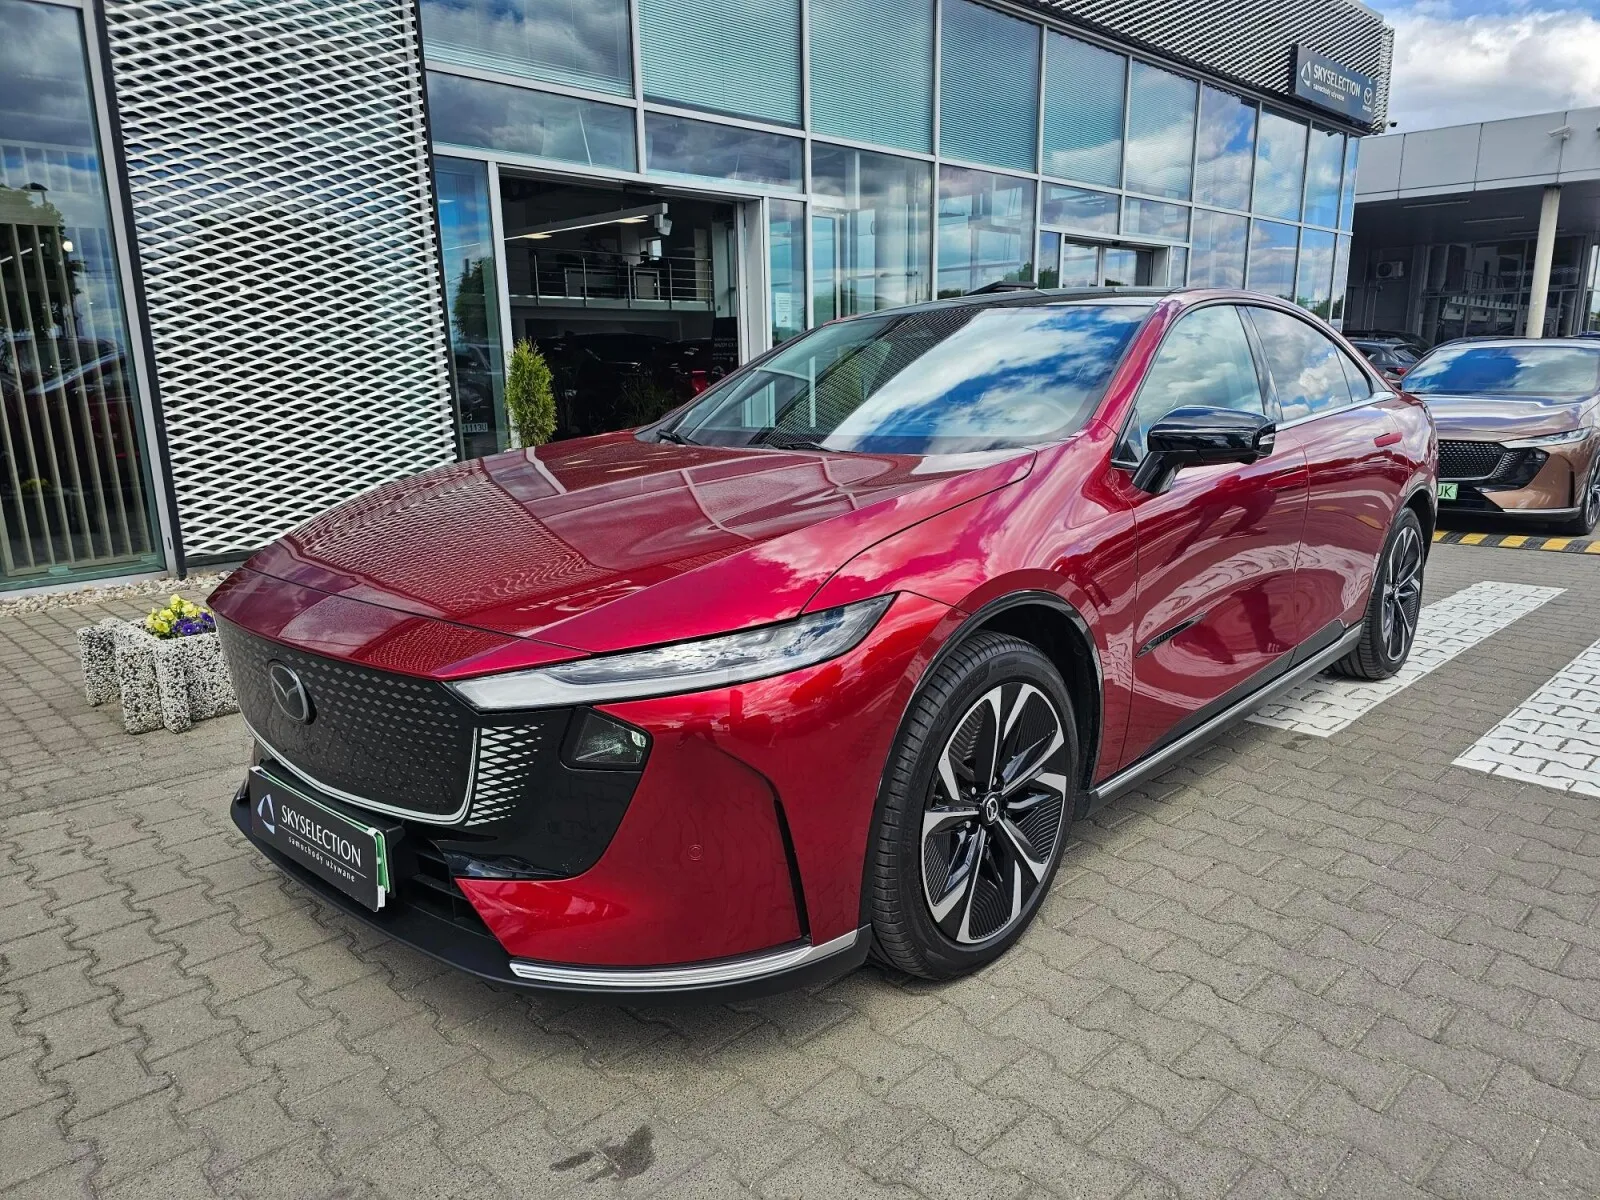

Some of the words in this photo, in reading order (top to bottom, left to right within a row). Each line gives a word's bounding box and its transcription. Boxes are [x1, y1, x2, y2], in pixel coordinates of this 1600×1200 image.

[1313, 64, 1361, 97] SKYSELECTION
[281, 804, 361, 868] SKYSELECTION
[288, 836, 324, 865] samochody
[325, 859, 355, 882] używane
